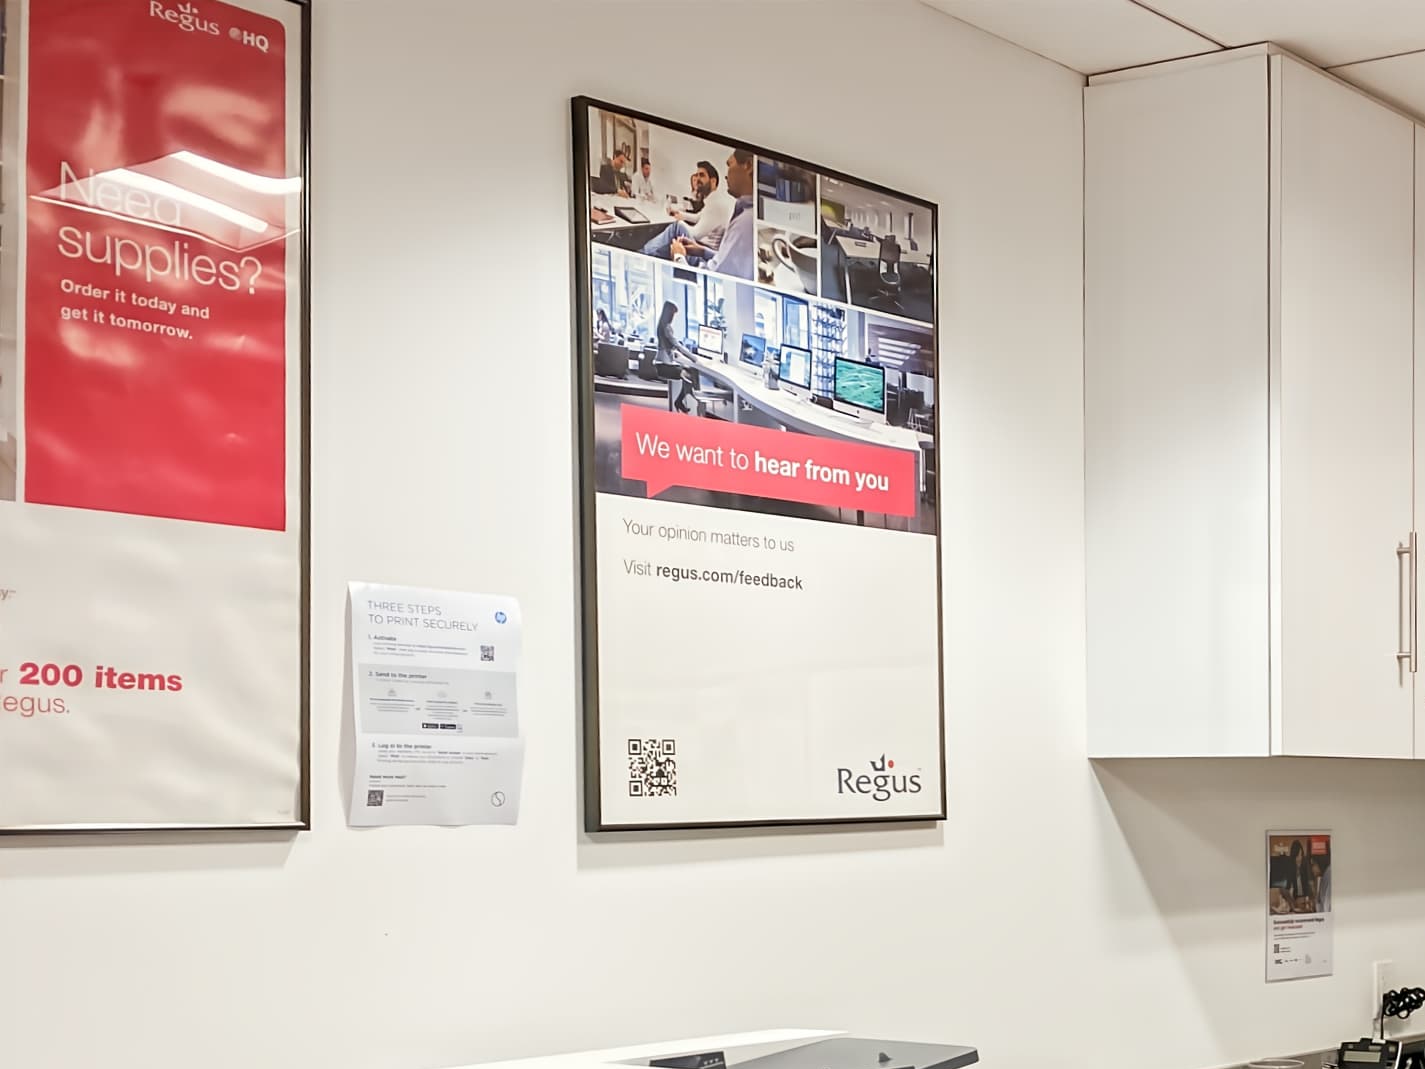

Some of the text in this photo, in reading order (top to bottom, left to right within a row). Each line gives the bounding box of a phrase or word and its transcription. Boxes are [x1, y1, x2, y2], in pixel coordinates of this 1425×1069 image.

[150, 0, 220, 35] Regus
[243, 31, 269, 52] HQ
[58, 226, 263, 294] supplies?
[60, 279, 210, 320] Order it today and
[60, 307, 193, 340] get it tomorrow.
[635, 432, 889, 492] We want to hear from you
[623, 518, 794, 552] Your opinion matters to us
[624, 560, 803, 590] Visit regus.com/feedback
[368, 600, 442, 616] THREE STEPS
[368, 614, 478, 632] TO PRINT SECURELY
[19, 662, 83, 687] 200
[95, 665, 183, 691] items
[0, 696, 70, 718] egus.
[837, 766, 922, 802] Regus
